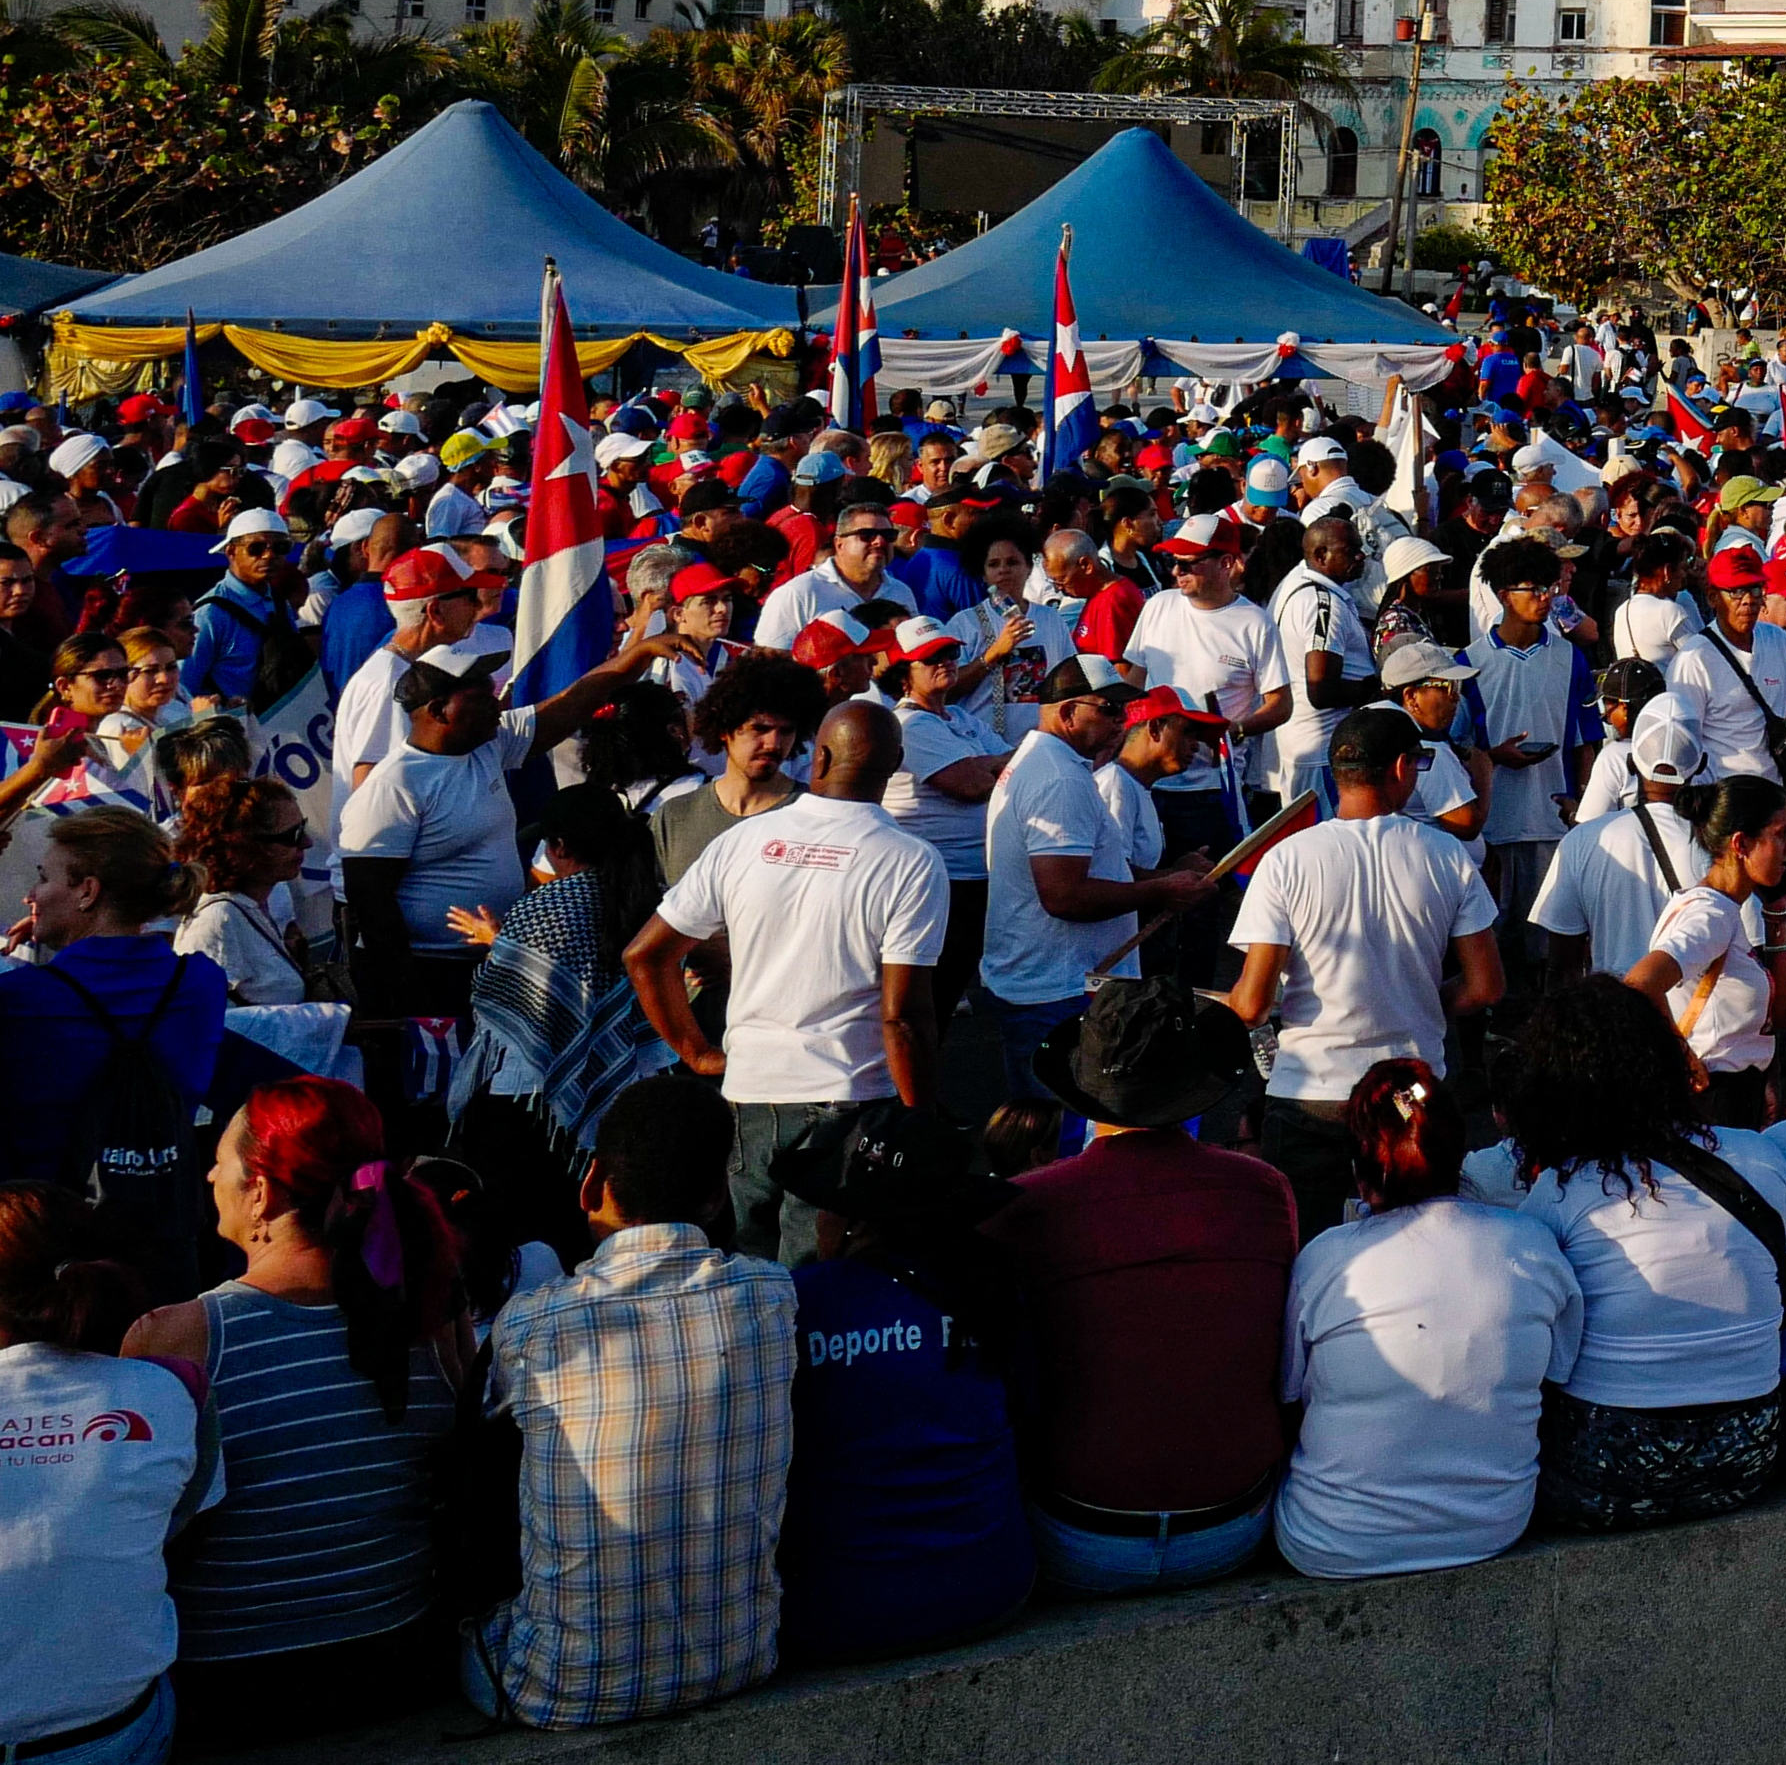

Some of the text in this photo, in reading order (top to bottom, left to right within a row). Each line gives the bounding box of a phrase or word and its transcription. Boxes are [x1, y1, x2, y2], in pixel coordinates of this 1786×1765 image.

[809, 1319, 922, 1366] Deporte
[8, 1453, 74, 1466] tu lado
